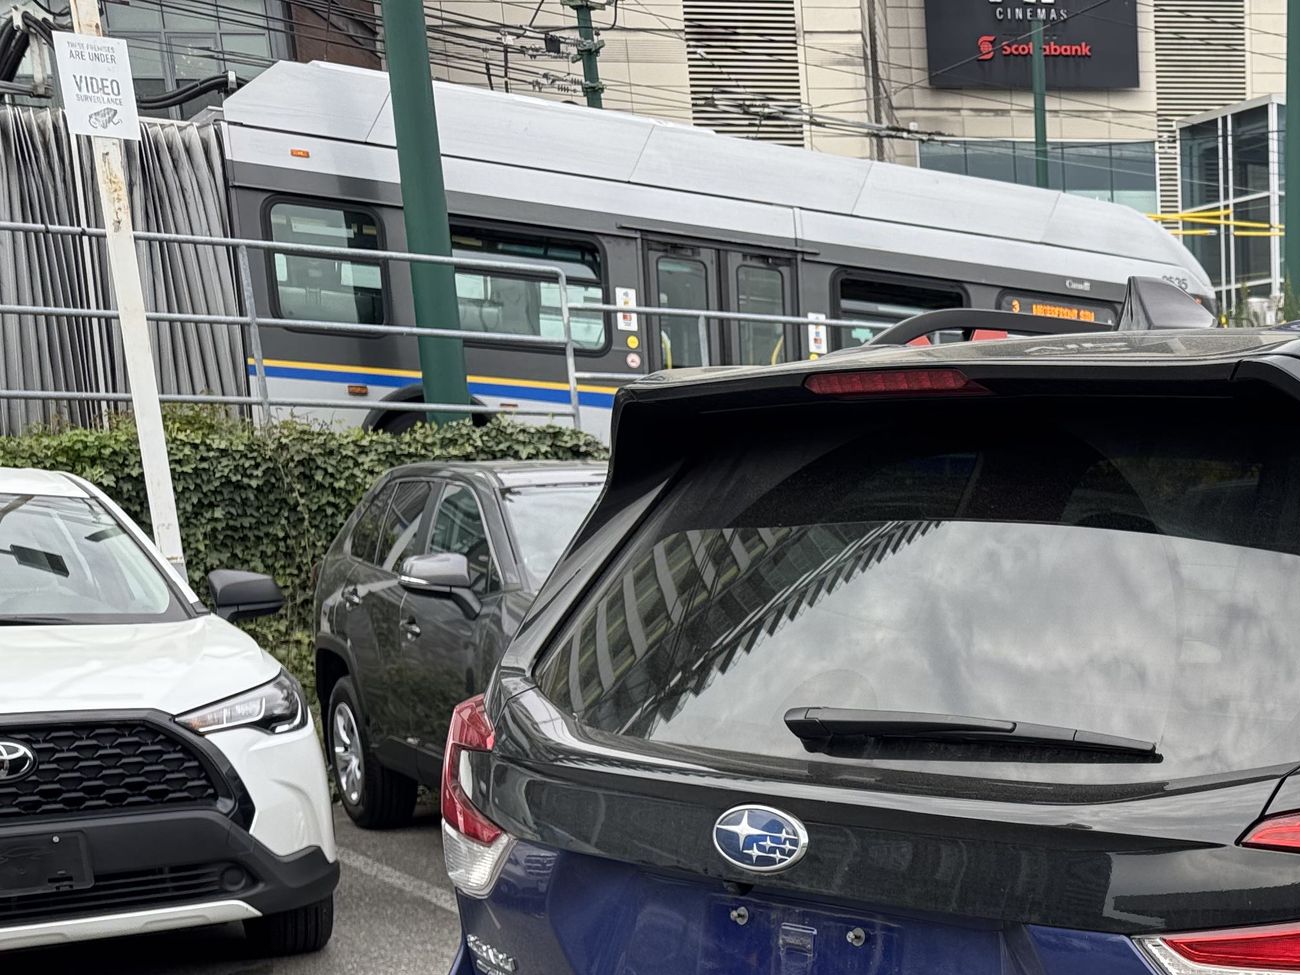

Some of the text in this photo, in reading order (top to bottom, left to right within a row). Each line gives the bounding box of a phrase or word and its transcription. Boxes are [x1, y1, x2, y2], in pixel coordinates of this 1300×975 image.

[995, 7, 1068, 21] CINEMAS
[69, 49, 117, 64] ARE UNDER
[1002, 41, 1091, 57] Scotabank
[73, 74, 120, 96] VIDEO
[1011, 299, 1020, 314] 3
